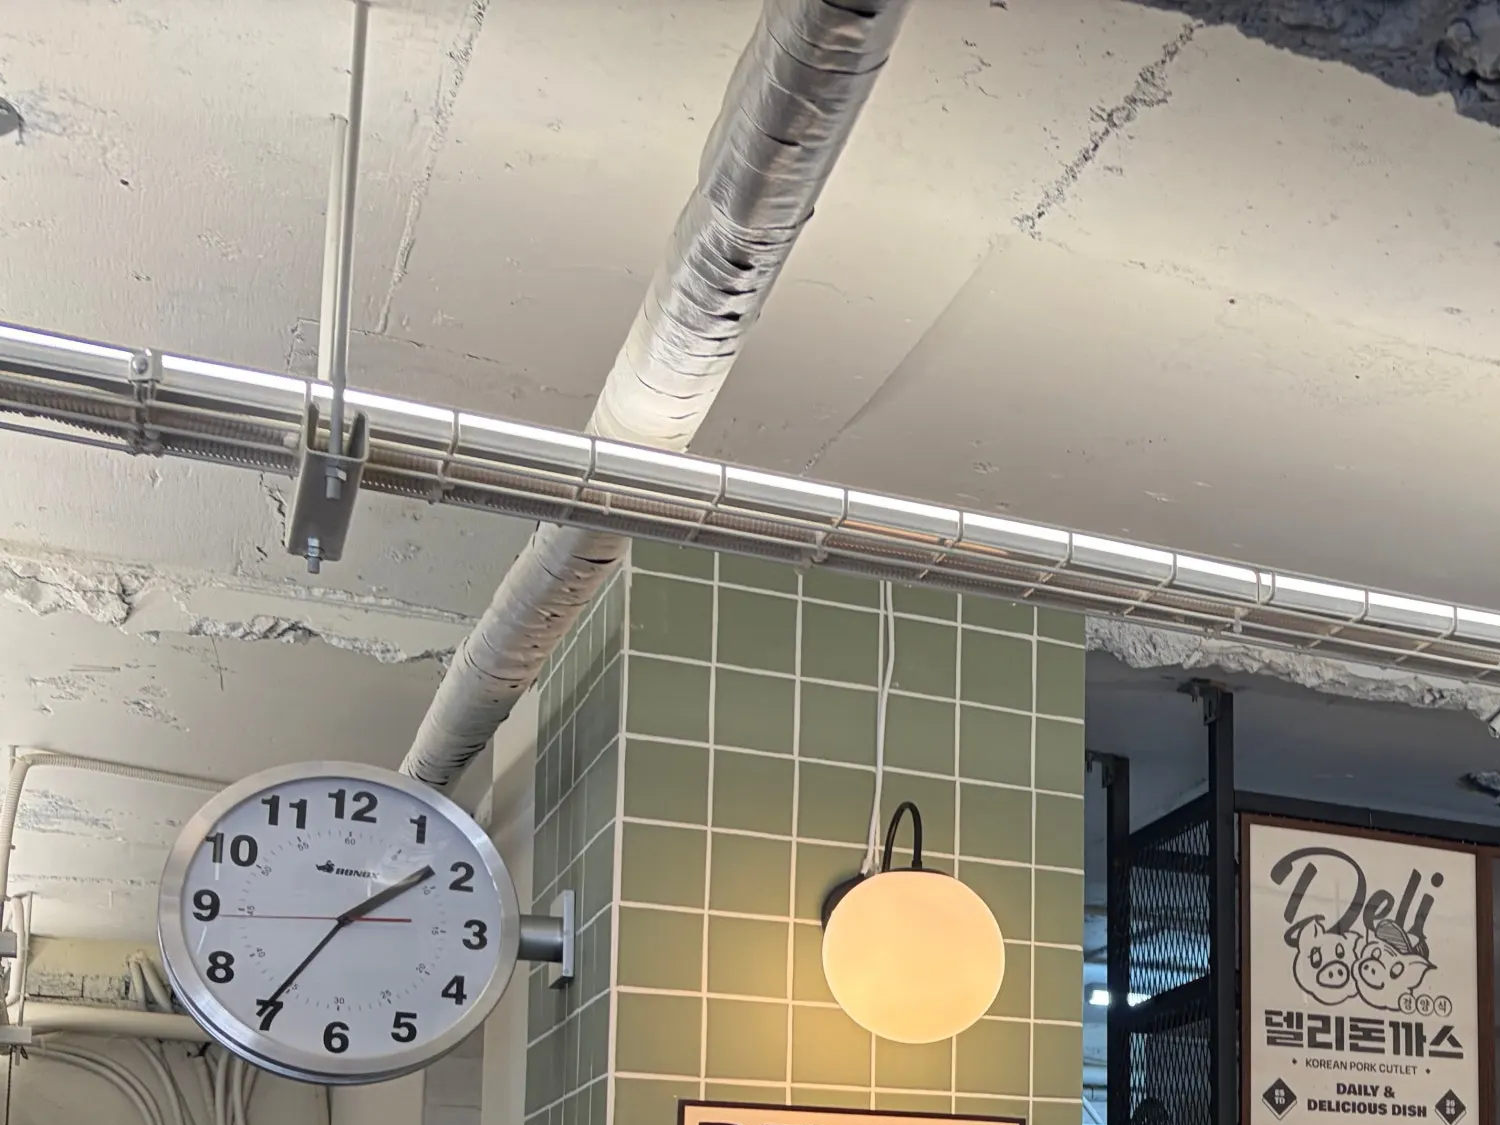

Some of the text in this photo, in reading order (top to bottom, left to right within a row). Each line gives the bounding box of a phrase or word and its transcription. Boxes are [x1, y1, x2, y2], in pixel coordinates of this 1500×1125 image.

[261, 794, 308, 830] 11
[328, 788, 379, 824] 12
[344, 837, 356, 846] 60
[409, 814, 427, 845] 1
[205, 832, 258, 867] 10
[449, 861, 475, 893] 2
[193, 889, 220, 922] 9
[1270, 846, 1445, 950] Deli
[462, 919, 488, 951] 3
[206, 951, 235, 984] 8
[334, 996, 345, 1005] 30
[380, 989, 392, 1000] 25
[441, 975, 467, 1006] 4
[255, 998, 284, 1031] 7
[391, 1012, 418, 1043] 5
[323, 1021, 350, 1054] 6
[1264, 1009, 1464, 1060] 델리돈까스
[1305, 1057, 1418, 1076] KOREAN PORK CUTLET
[1336, 1082, 1395, 1099] DAILY &
[1307, 1098, 1428, 1118] DELICIOUS DISH
